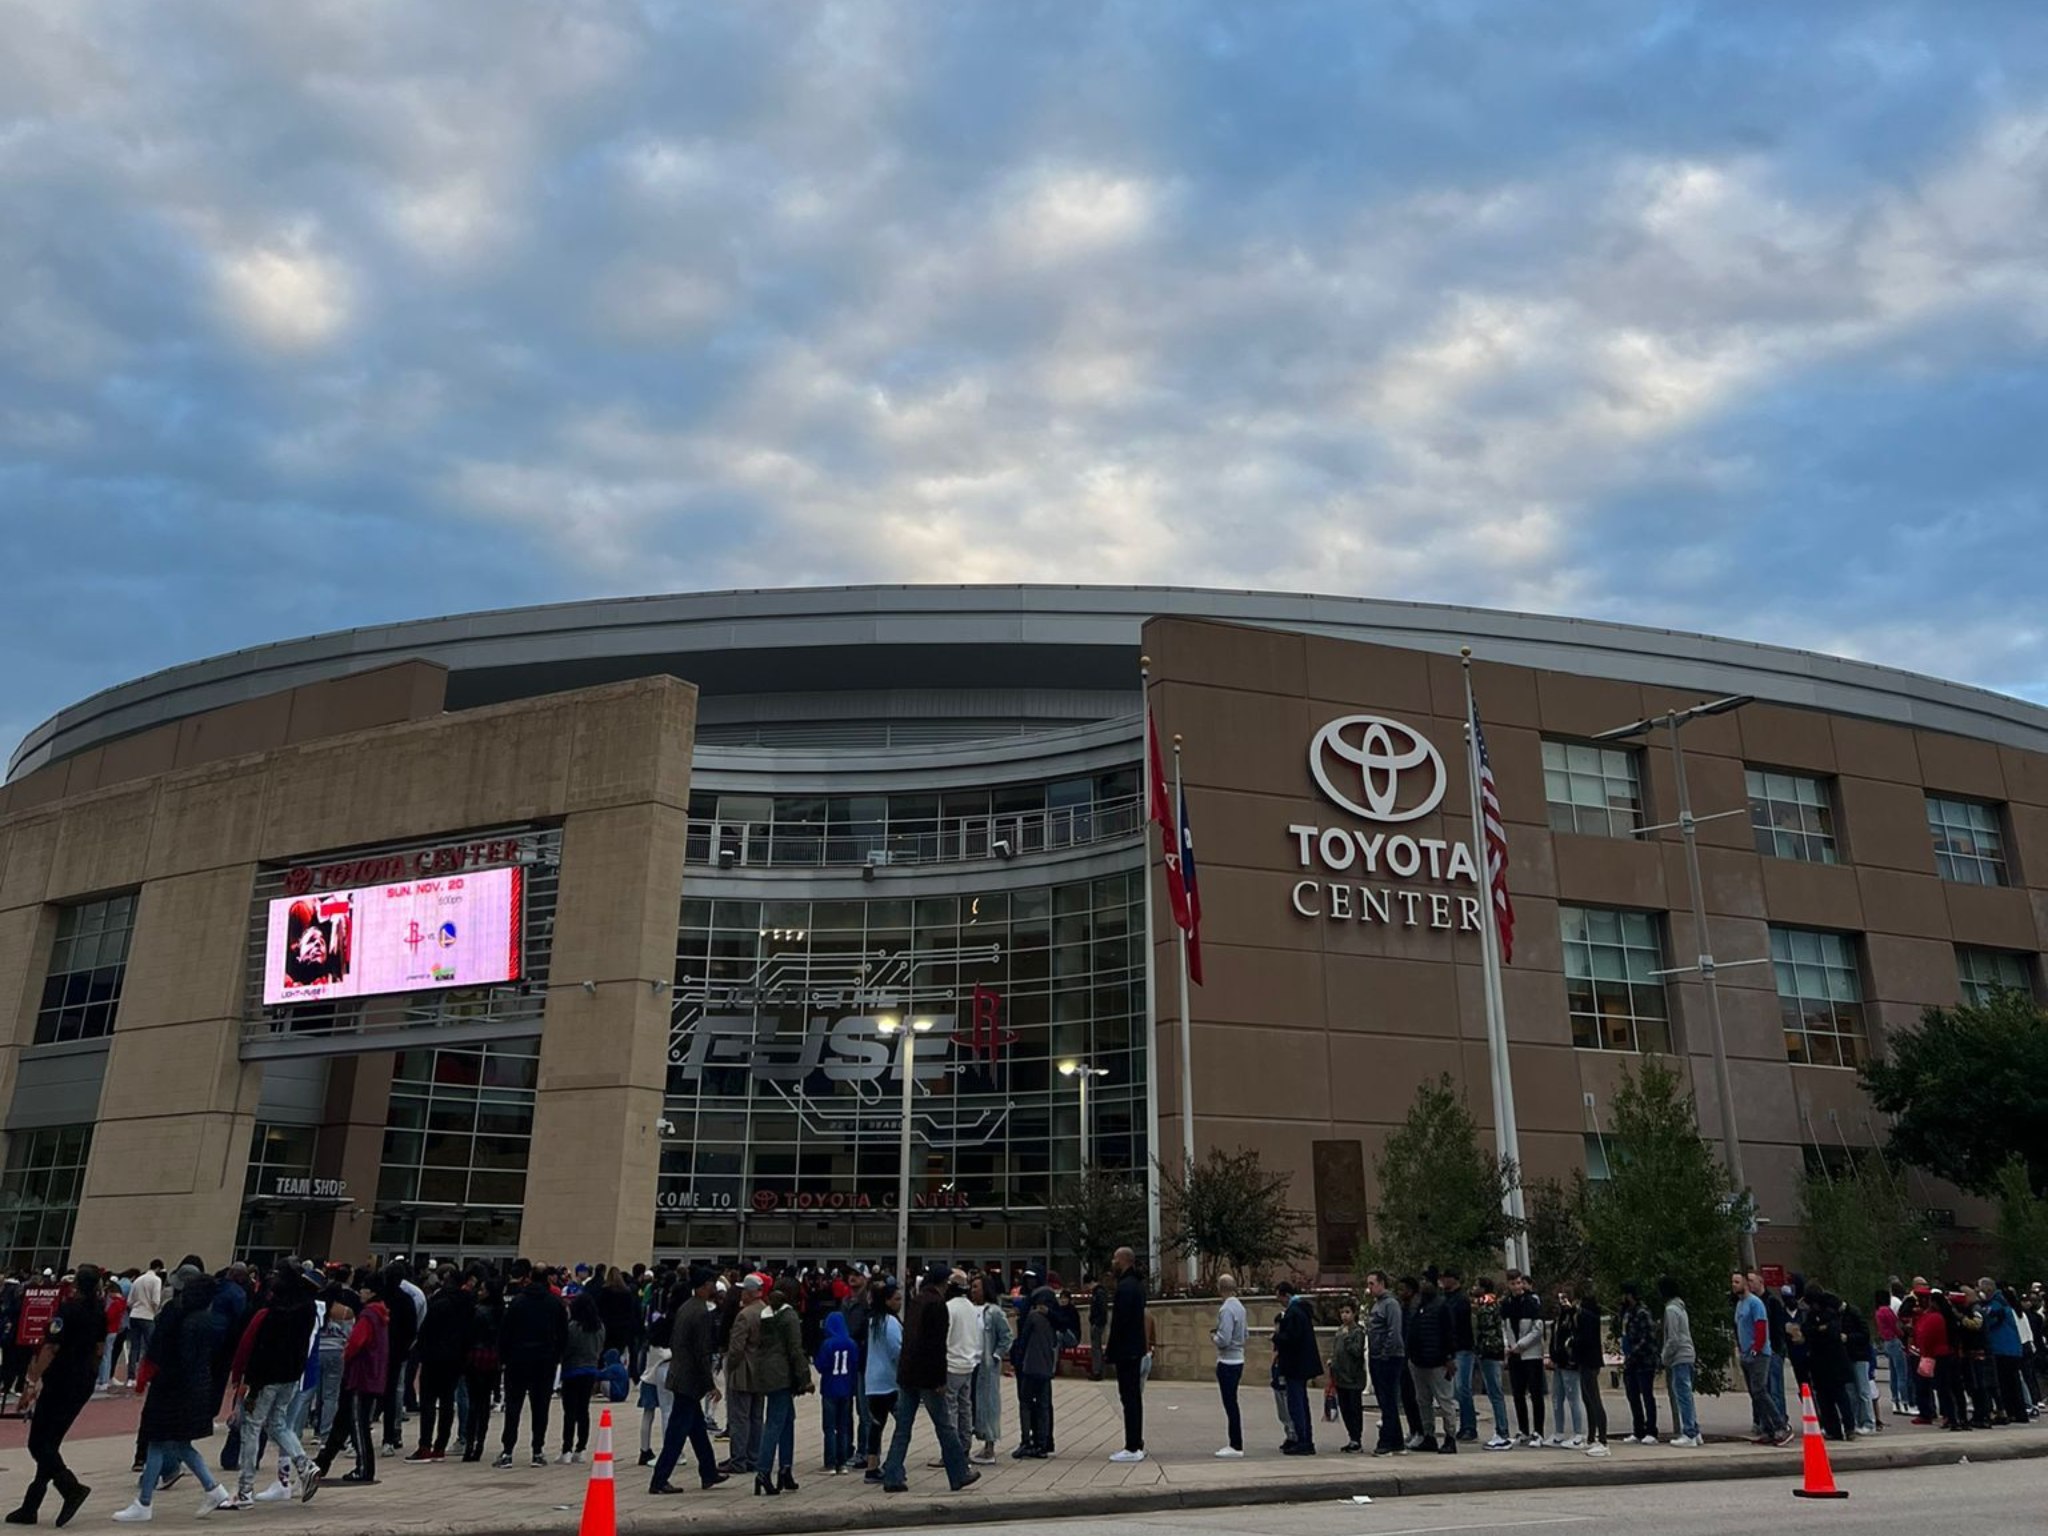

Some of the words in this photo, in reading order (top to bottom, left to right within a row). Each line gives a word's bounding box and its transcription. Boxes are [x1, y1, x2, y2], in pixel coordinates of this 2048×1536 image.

[318, 856, 405, 887] TOYOTA
[414, 839, 519, 874] CENTER
[1289, 824, 1479, 883] TOYOTA
[416, 881, 444, 895] NOV.
[447, 878, 464, 890] 20
[1291, 880, 1482, 931] CENTER
[681, 1015, 957, 1080] FUSE
[276, 1177, 310, 1195] TEAM
[313, 1178, 347, 1196] SHOP
[711, 1192, 731, 1207] TO
[784, 1192, 871, 1208] TOYOTA
[882, 1192, 971, 1208] CNTER
[832, 1349, 849, 1376] 11
